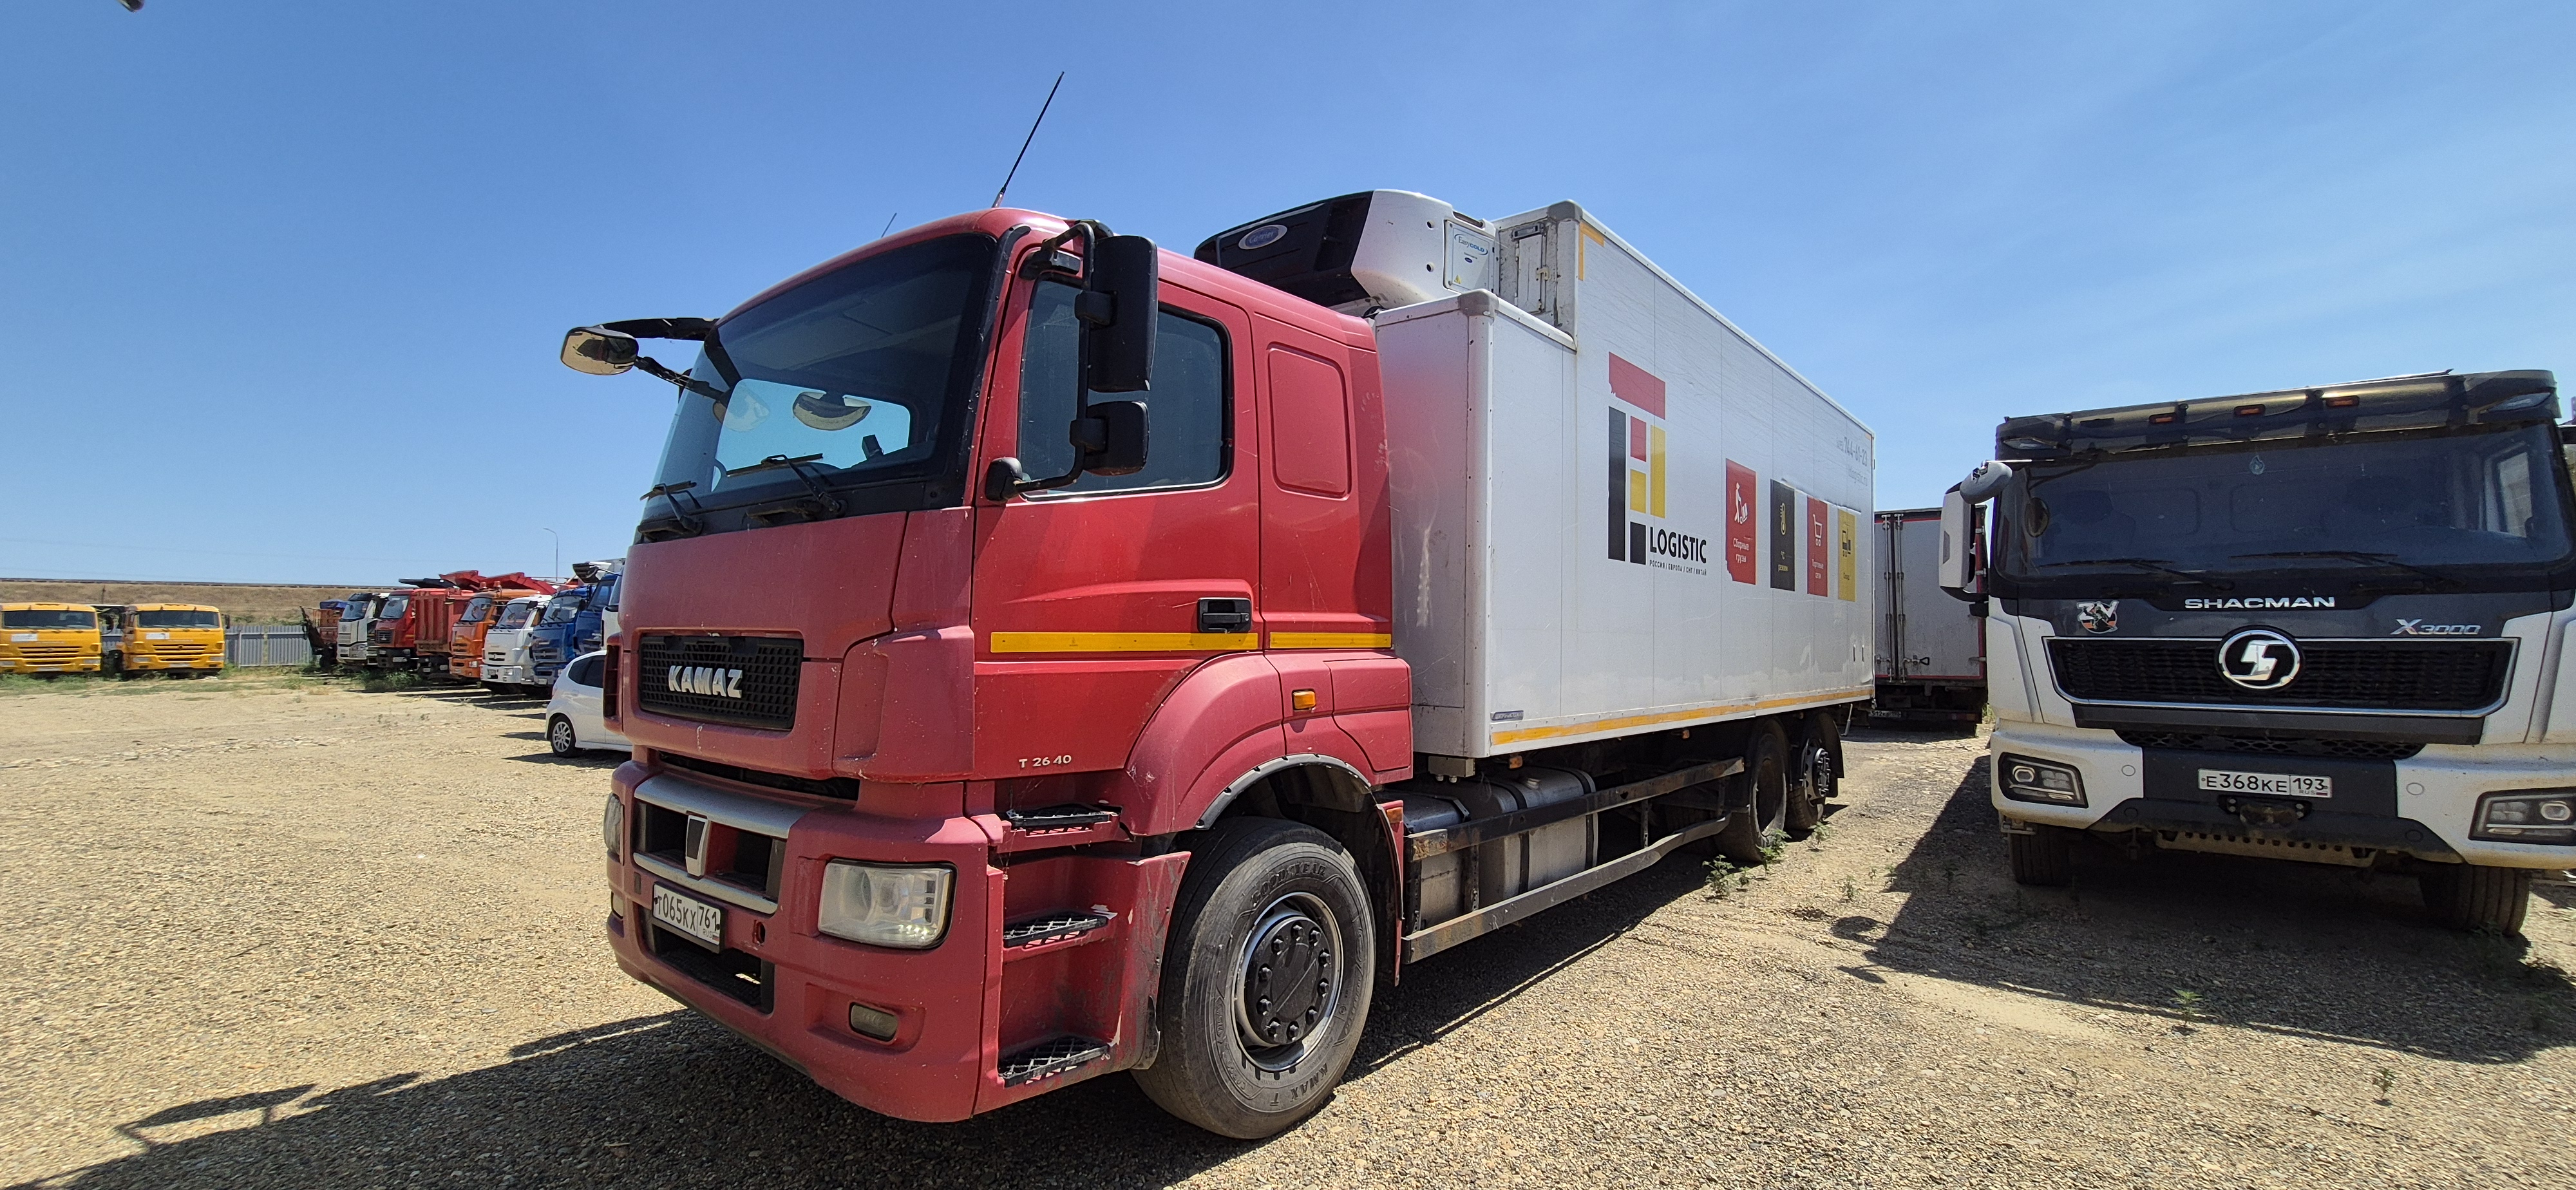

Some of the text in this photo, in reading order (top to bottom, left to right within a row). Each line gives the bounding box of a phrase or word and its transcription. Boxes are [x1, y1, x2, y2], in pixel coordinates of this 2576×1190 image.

[1458, 236, 1485, 252] EasyCOLD
[1649, 526, 1707, 564] LOGISTIC
[1649, 559, 1665, 569] РОССИЯ
[2184, 597, 2336, 609] SHACMAN
[2390, 618, 2481, 635] X3000
[668, 665, 743, 699] KAMAZ
[1018, 758, 1028, 768] T
